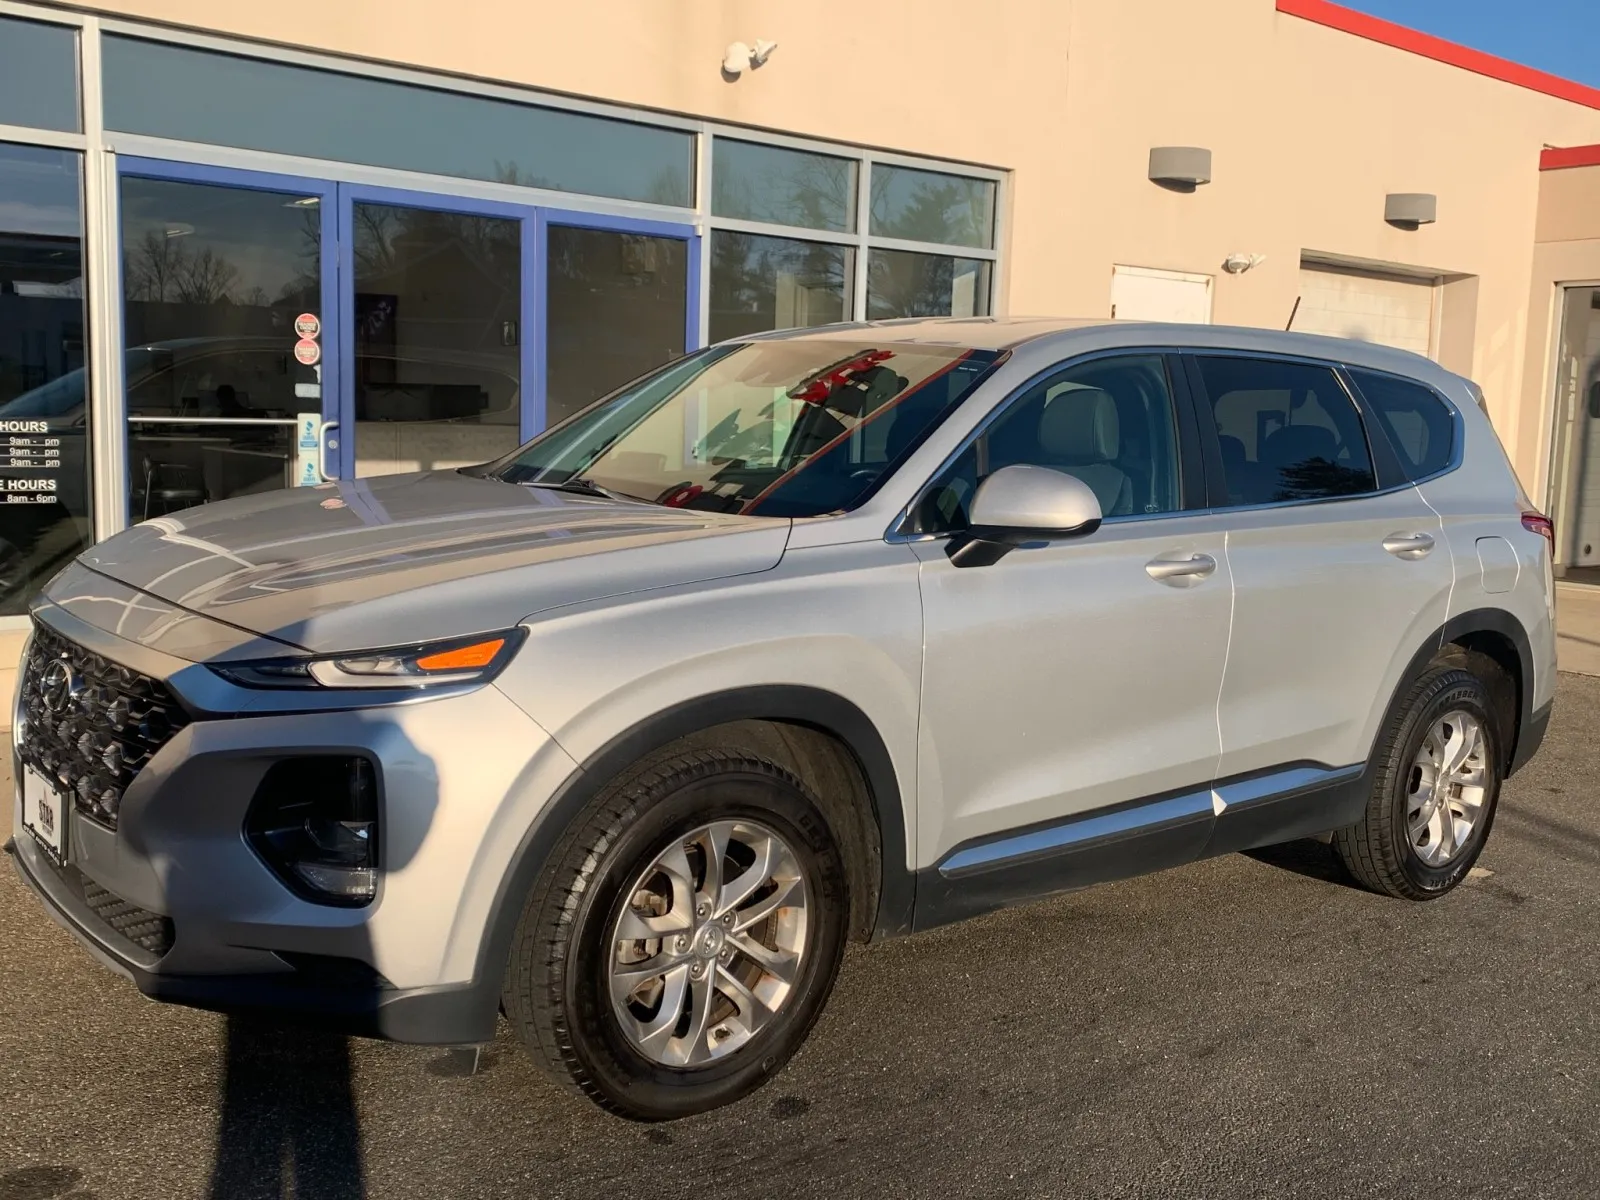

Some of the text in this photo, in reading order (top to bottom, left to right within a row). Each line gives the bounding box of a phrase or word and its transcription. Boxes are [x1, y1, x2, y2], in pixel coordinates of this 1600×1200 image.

[0, 421, 48, 431] HOURS
[9, 436, 30, 446] 9am
[9, 447, 30, 456] 9am
[10, 458, 31, 467] 9am
[8, 479, 56, 490] HOURS
[7, 494, 28, 503] 8am
[36, 493, 57, 504] 6pm
[39, 799, 54, 832] STAR
